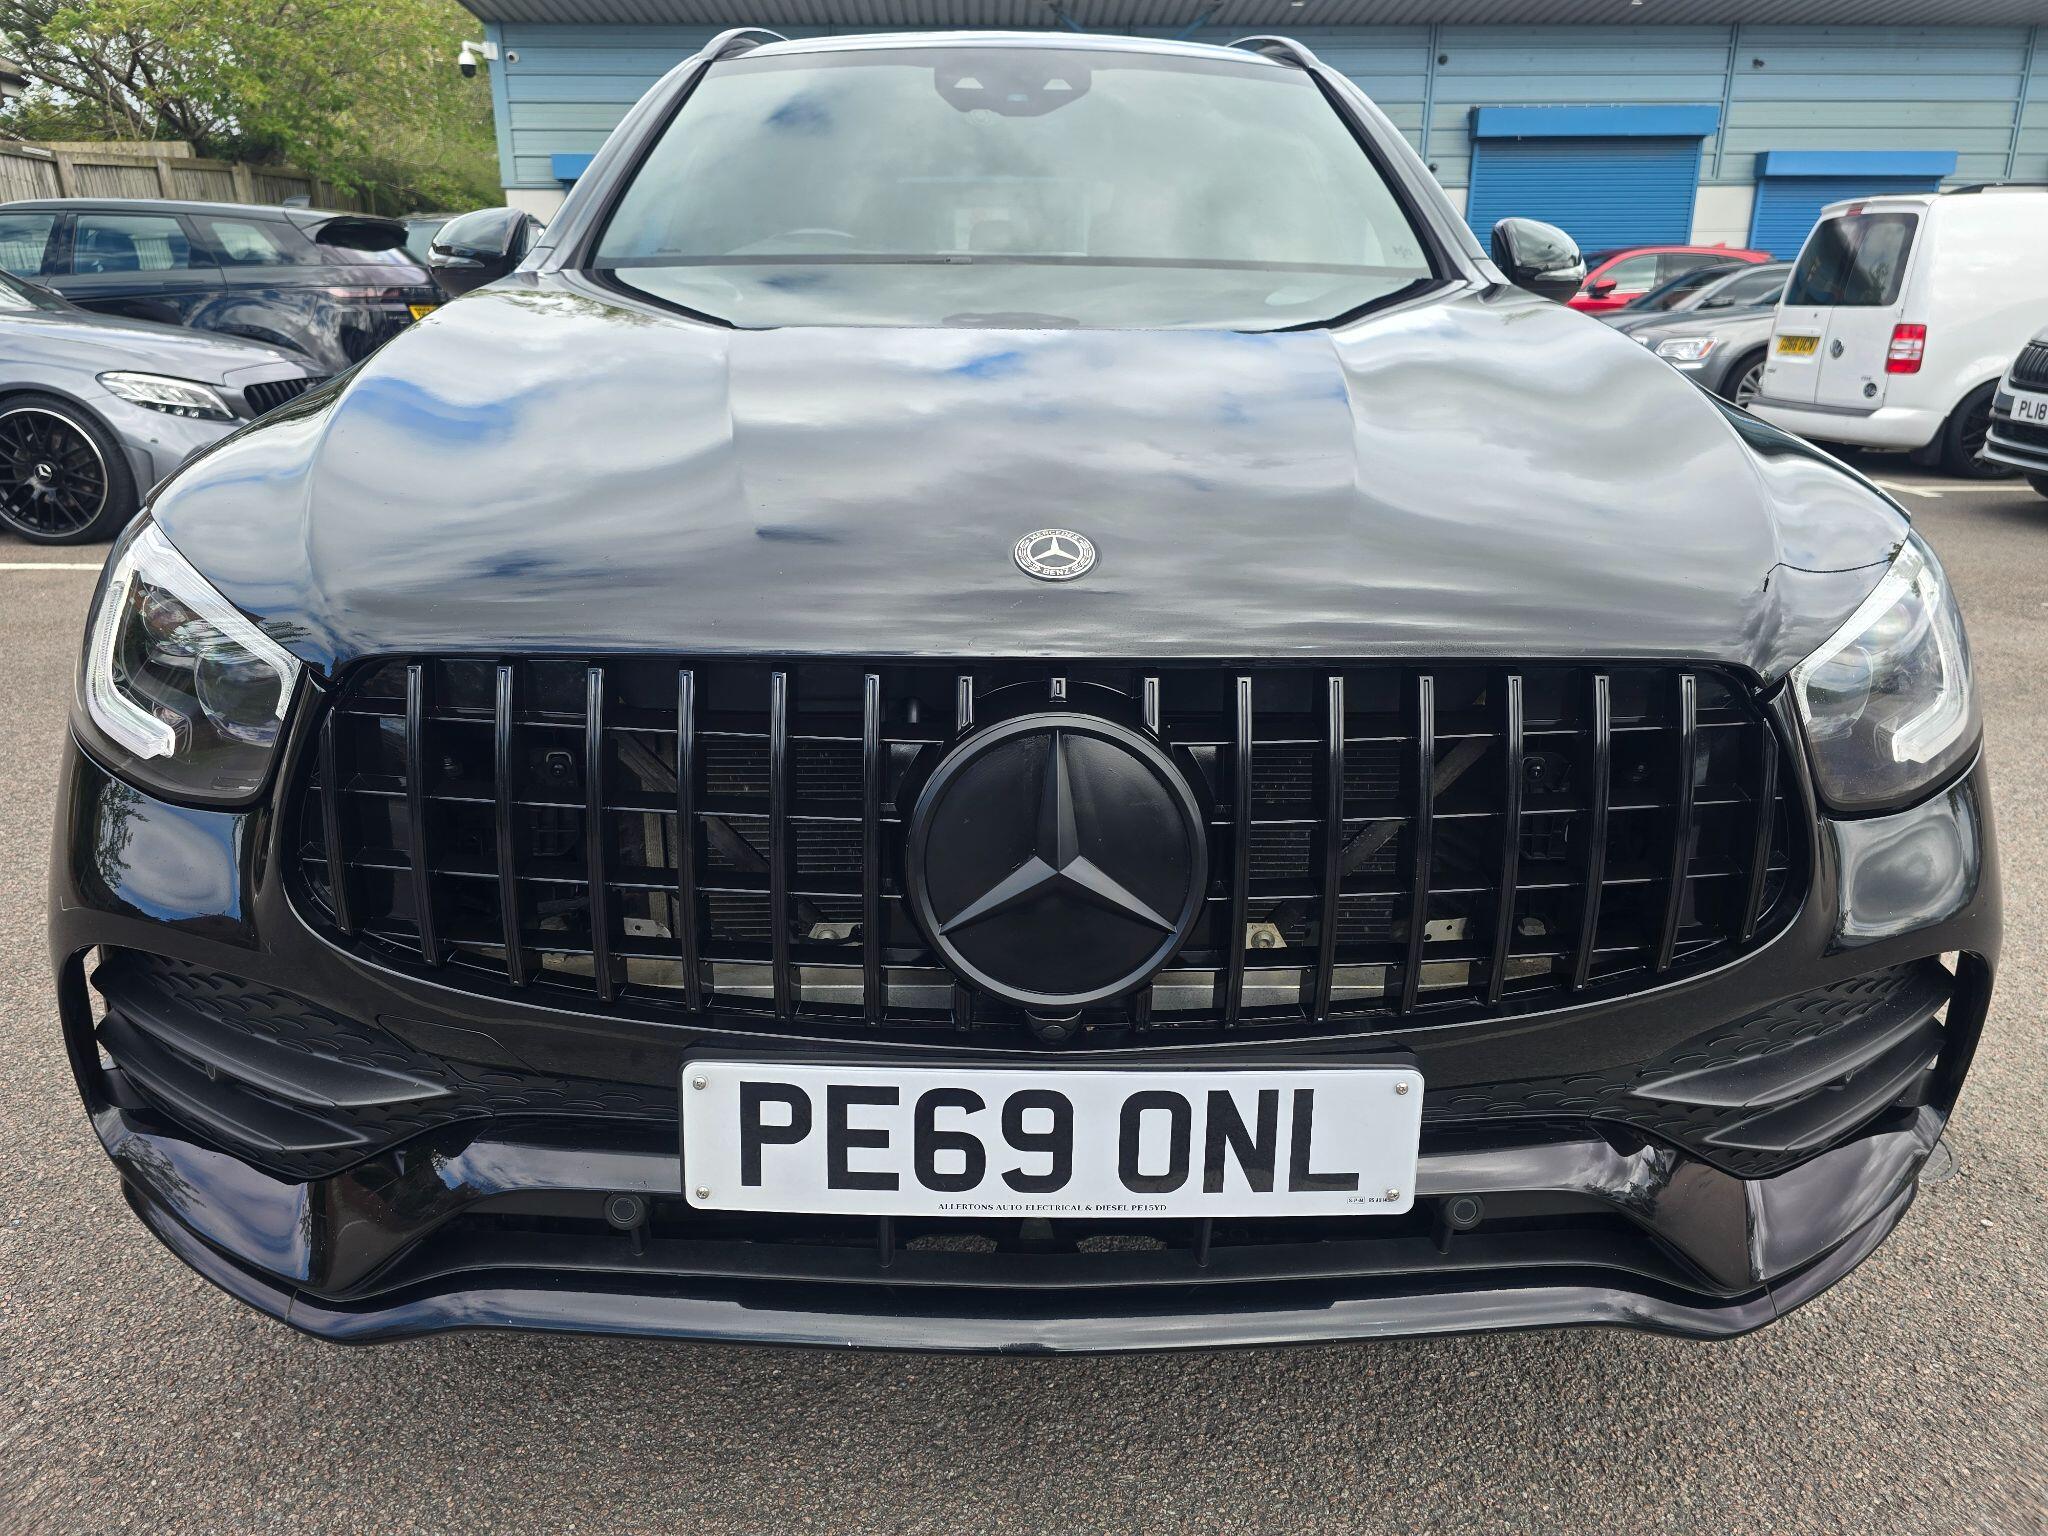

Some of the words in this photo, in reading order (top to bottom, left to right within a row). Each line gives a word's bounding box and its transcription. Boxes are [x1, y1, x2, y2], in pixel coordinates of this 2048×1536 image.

[2018, 400, 2047, 420] PL18
[1042, 568, 1070, 577] BENZ
[740, 1081, 1074, 1193] PE69
[1118, 1089, 1360, 1193] ONL
[938, 1203, 994, 1211] ALLERTONS
[1095, 1204, 1129, 1212] DIESEL
